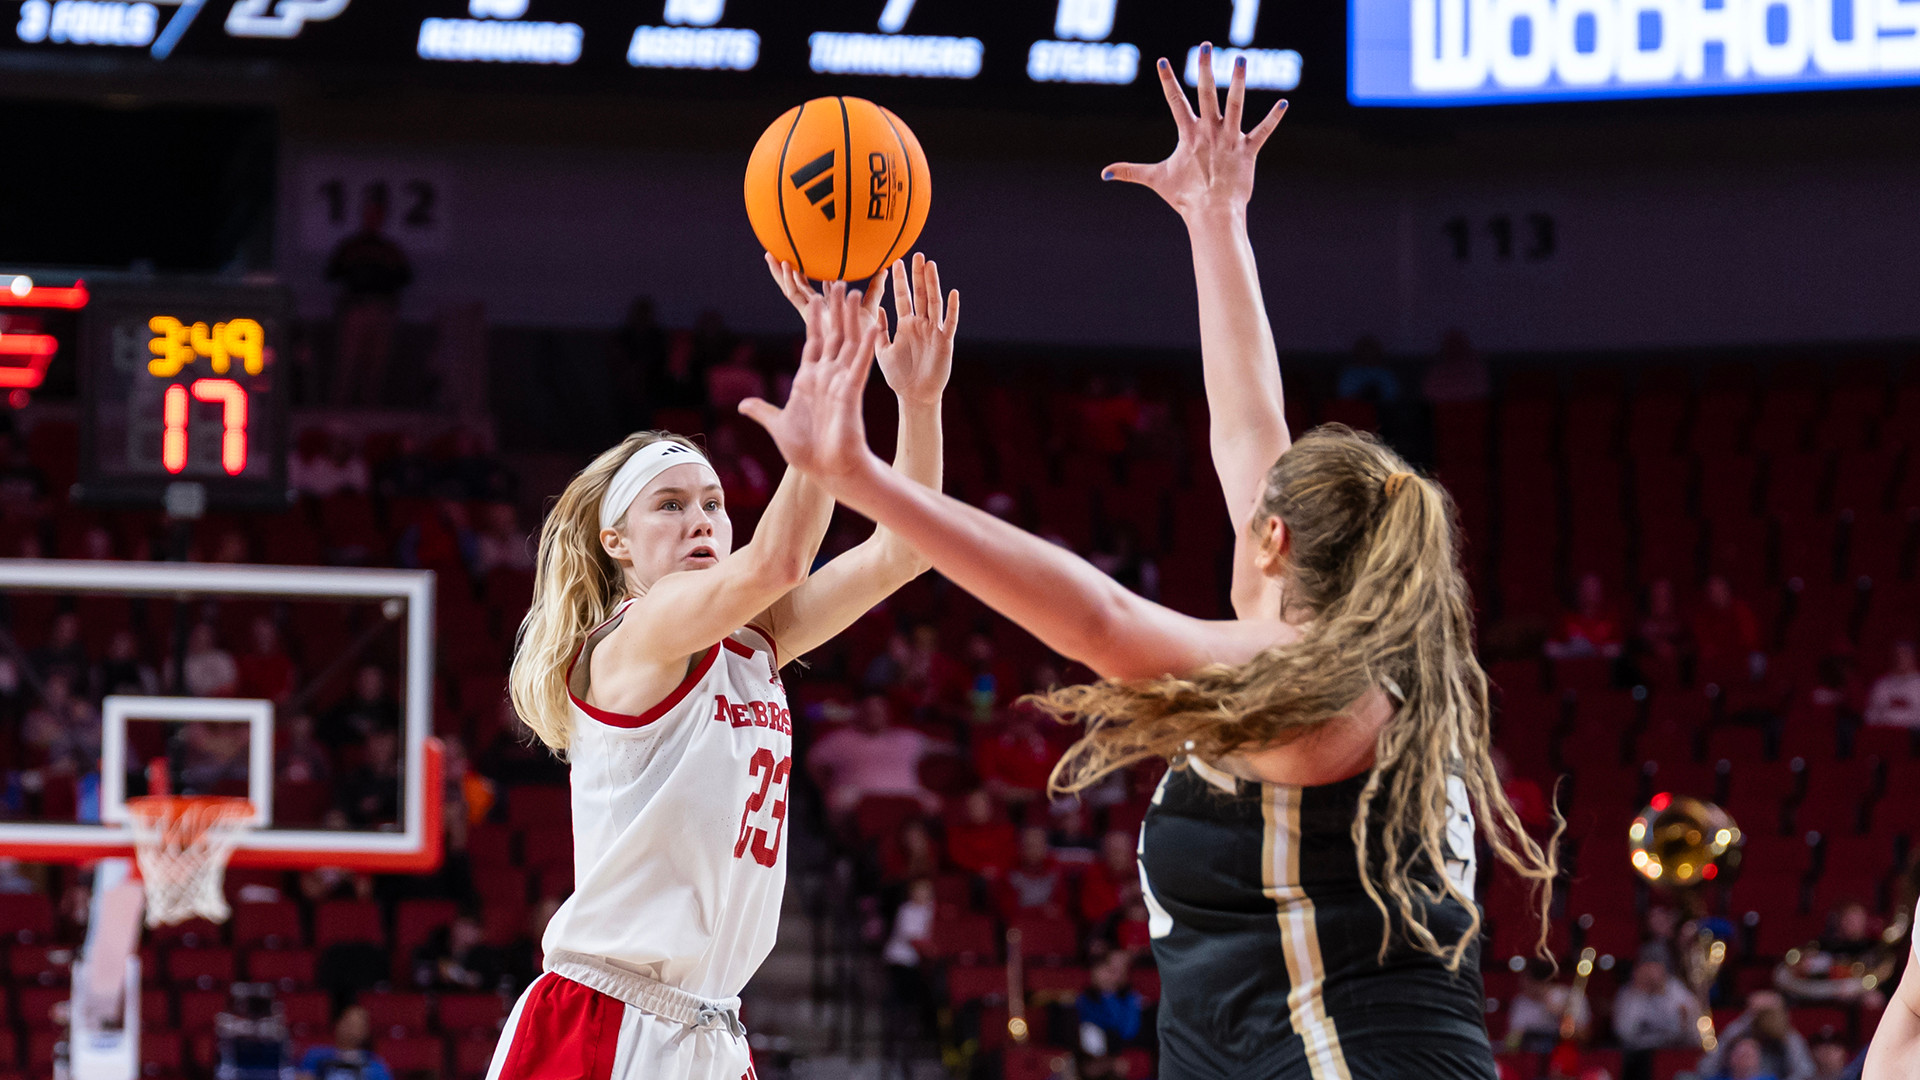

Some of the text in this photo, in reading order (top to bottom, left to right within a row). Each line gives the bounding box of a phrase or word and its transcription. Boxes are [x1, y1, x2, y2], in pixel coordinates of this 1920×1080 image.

[417, 18, 583, 65] REBOUNDS
[809, 32, 984, 78] TURNOVERS
[1027, 40, 1140, 84] STEALS
[319, 178, 437, 226] 112
[867, 152, 888, 220] PRO
[1444, 213, 1555, 260] 113
[148, 316, 265, 376] 3:49
[162, 378, 248, 476] 17
[734, 747, 792, 868] 23
